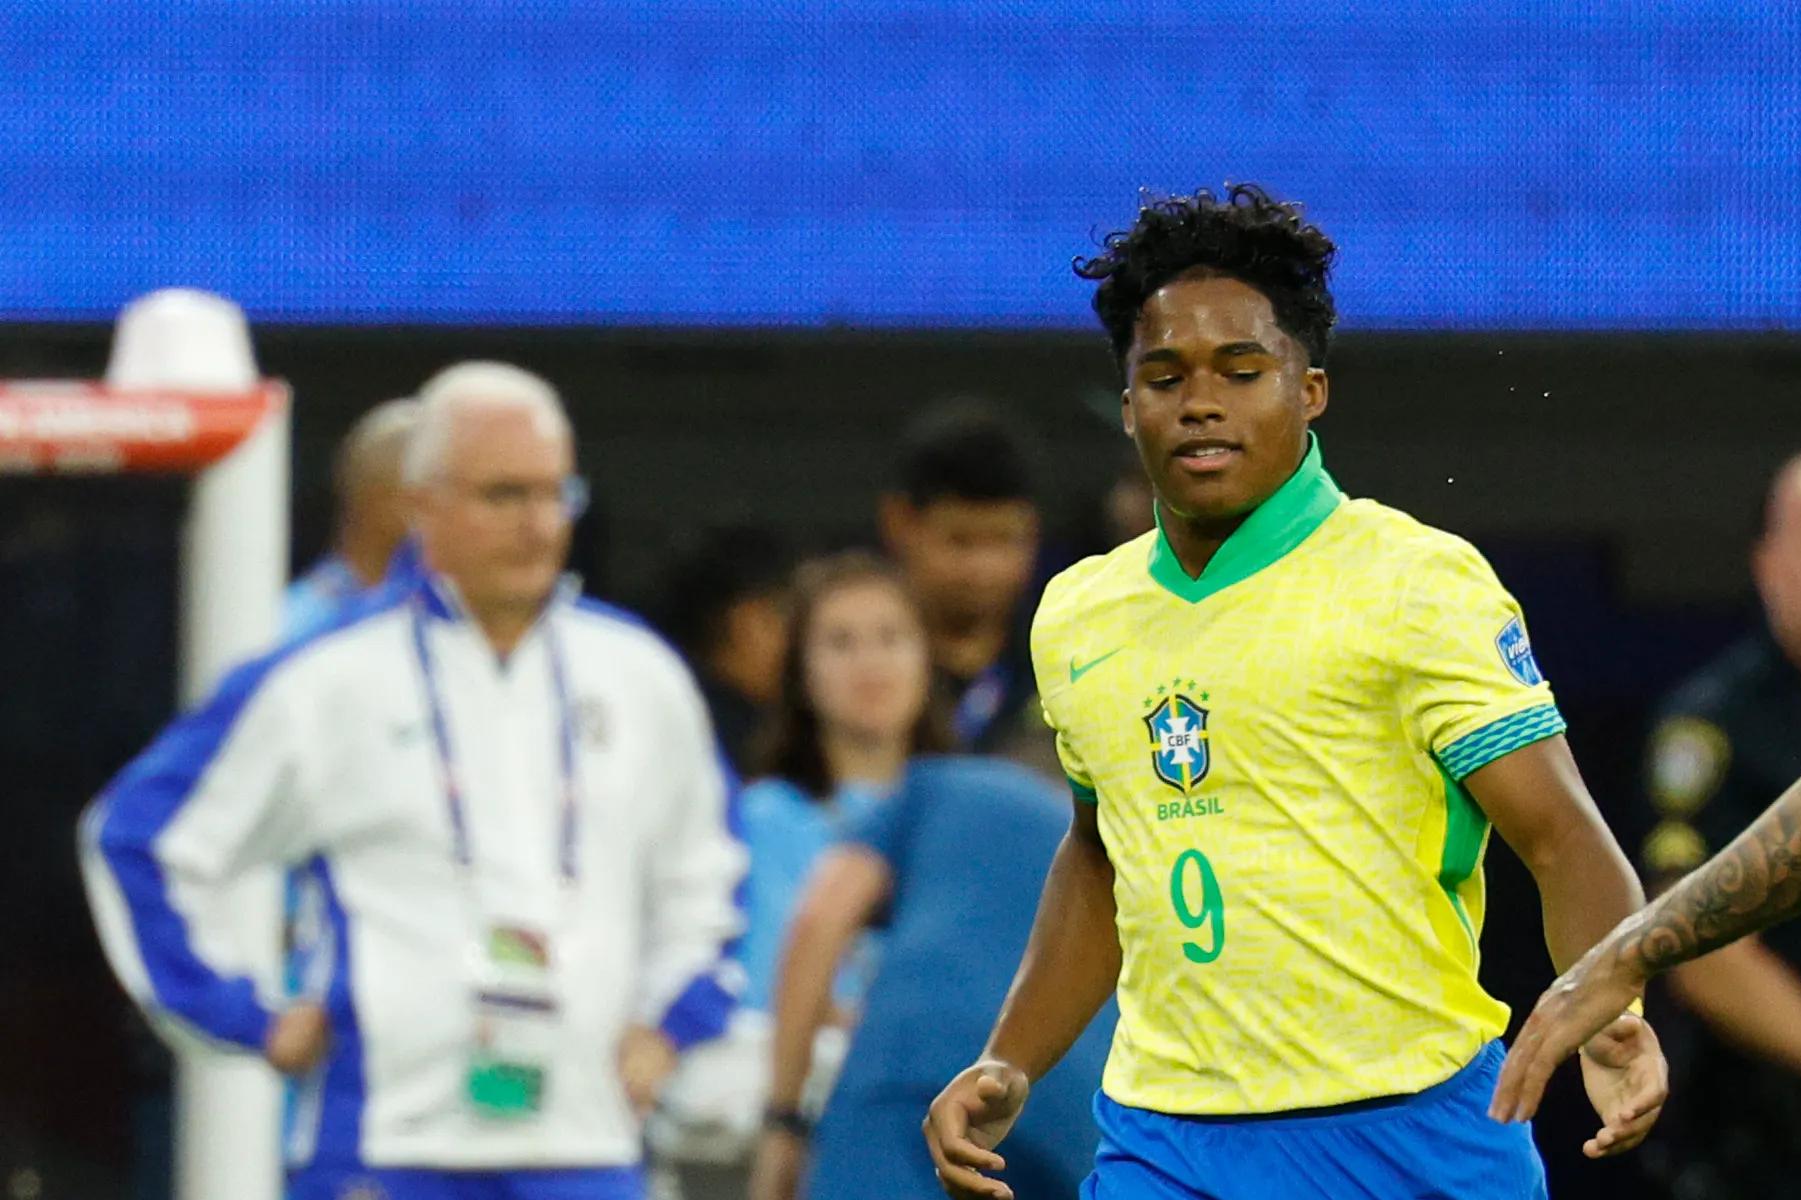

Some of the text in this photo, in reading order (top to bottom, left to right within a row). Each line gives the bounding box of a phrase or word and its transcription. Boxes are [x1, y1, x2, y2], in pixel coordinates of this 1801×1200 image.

[1167, 734, 1191, 747] CBF
[1157, 797, 1225, 821] BRASIL
[1169, 848, 1225, 964] 9
